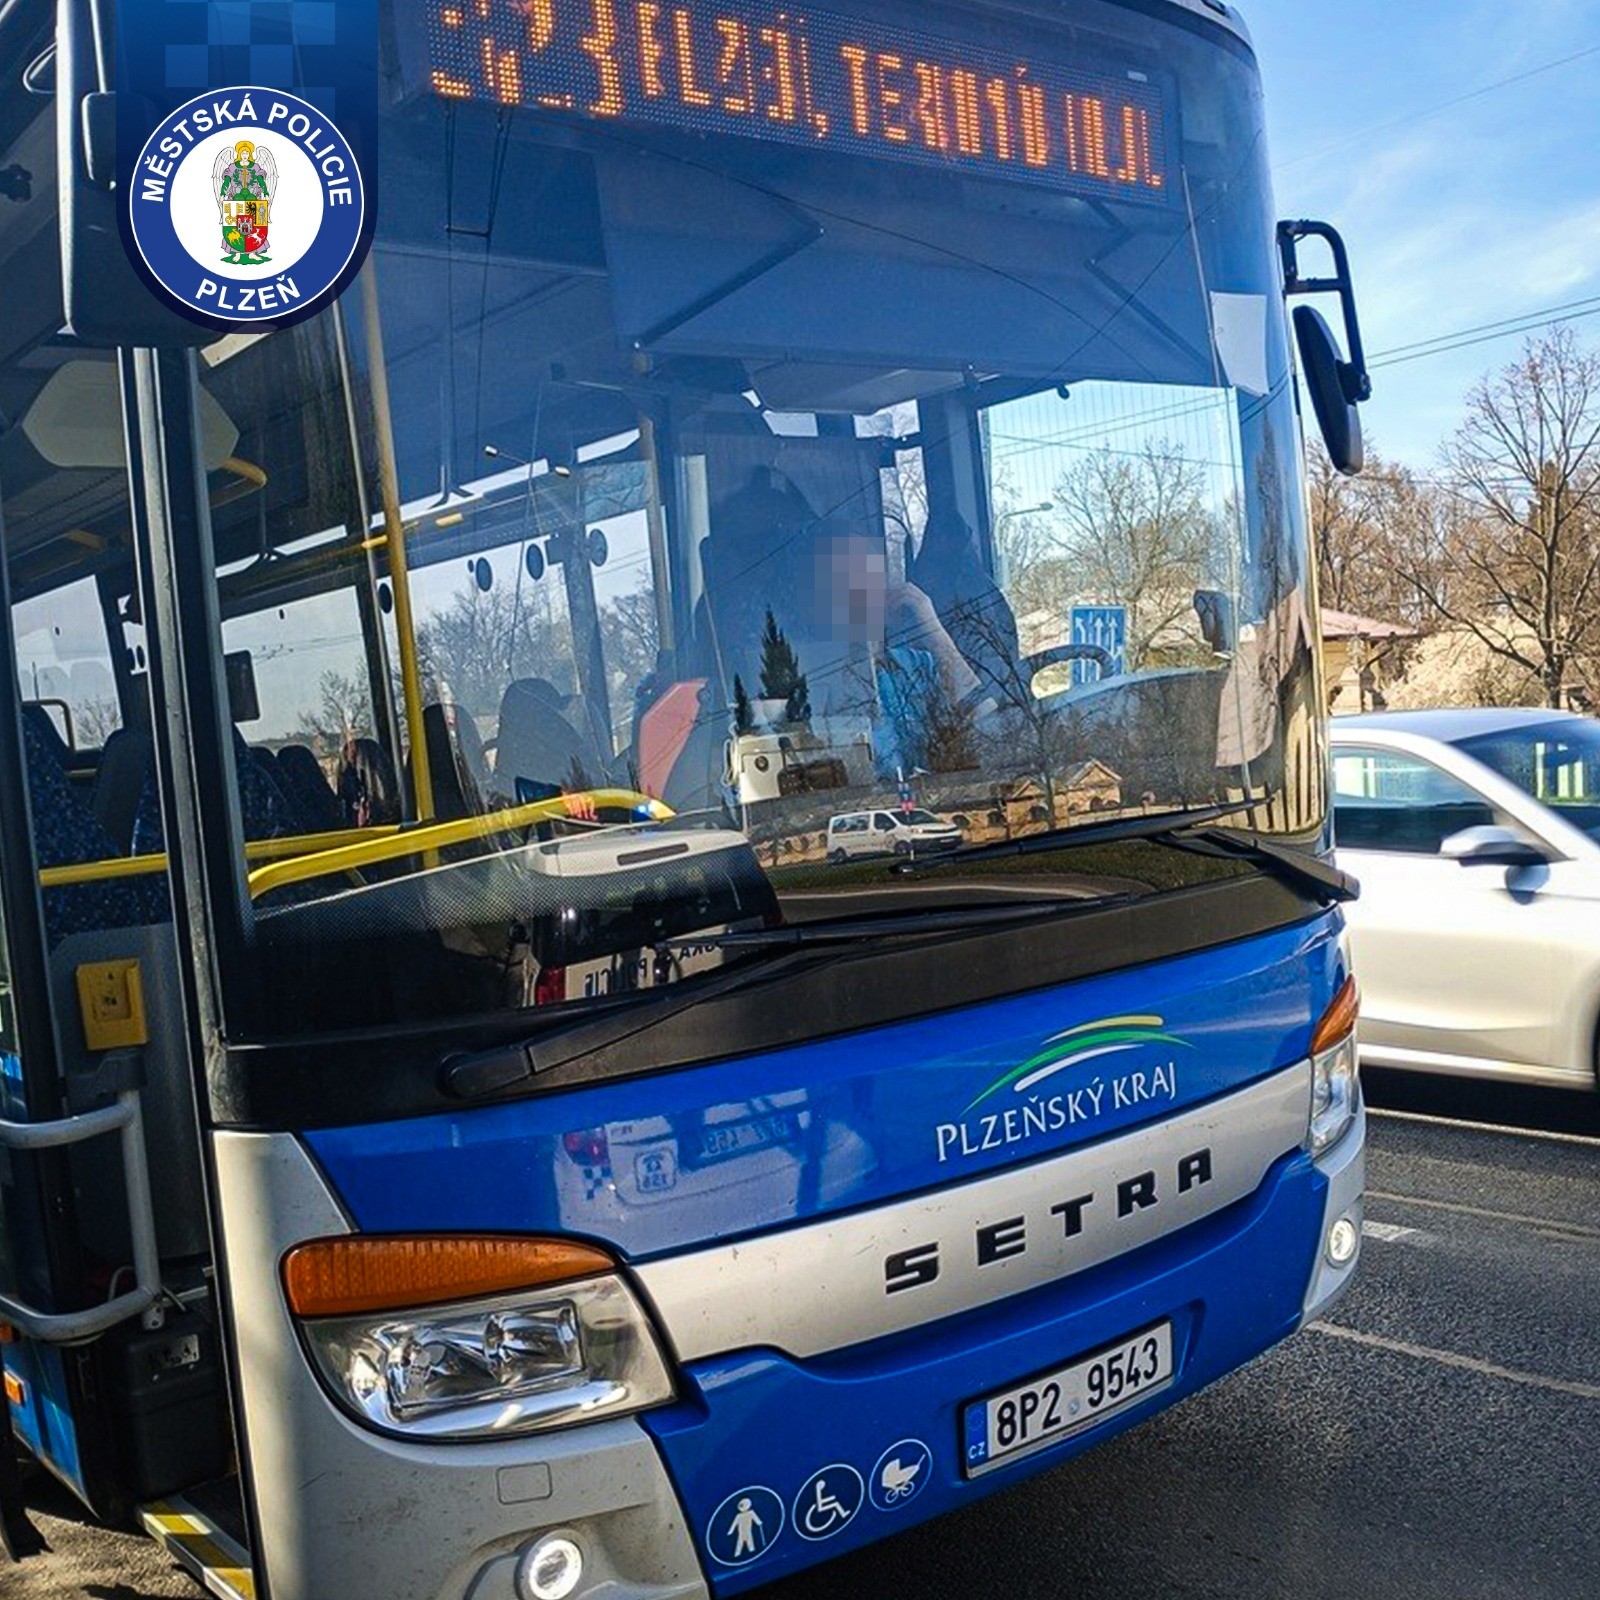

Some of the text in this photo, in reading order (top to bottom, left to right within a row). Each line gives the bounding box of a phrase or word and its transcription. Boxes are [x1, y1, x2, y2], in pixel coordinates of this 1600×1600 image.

[936, 1062, 1177, 1162] PLZEŇSKÝ KRAJ
[885, 1148, 1212, 1295] SETRA
[996, 1337, 1158, 1447] 8P2 9543
[968, 1441, 985, 1460] CZ
